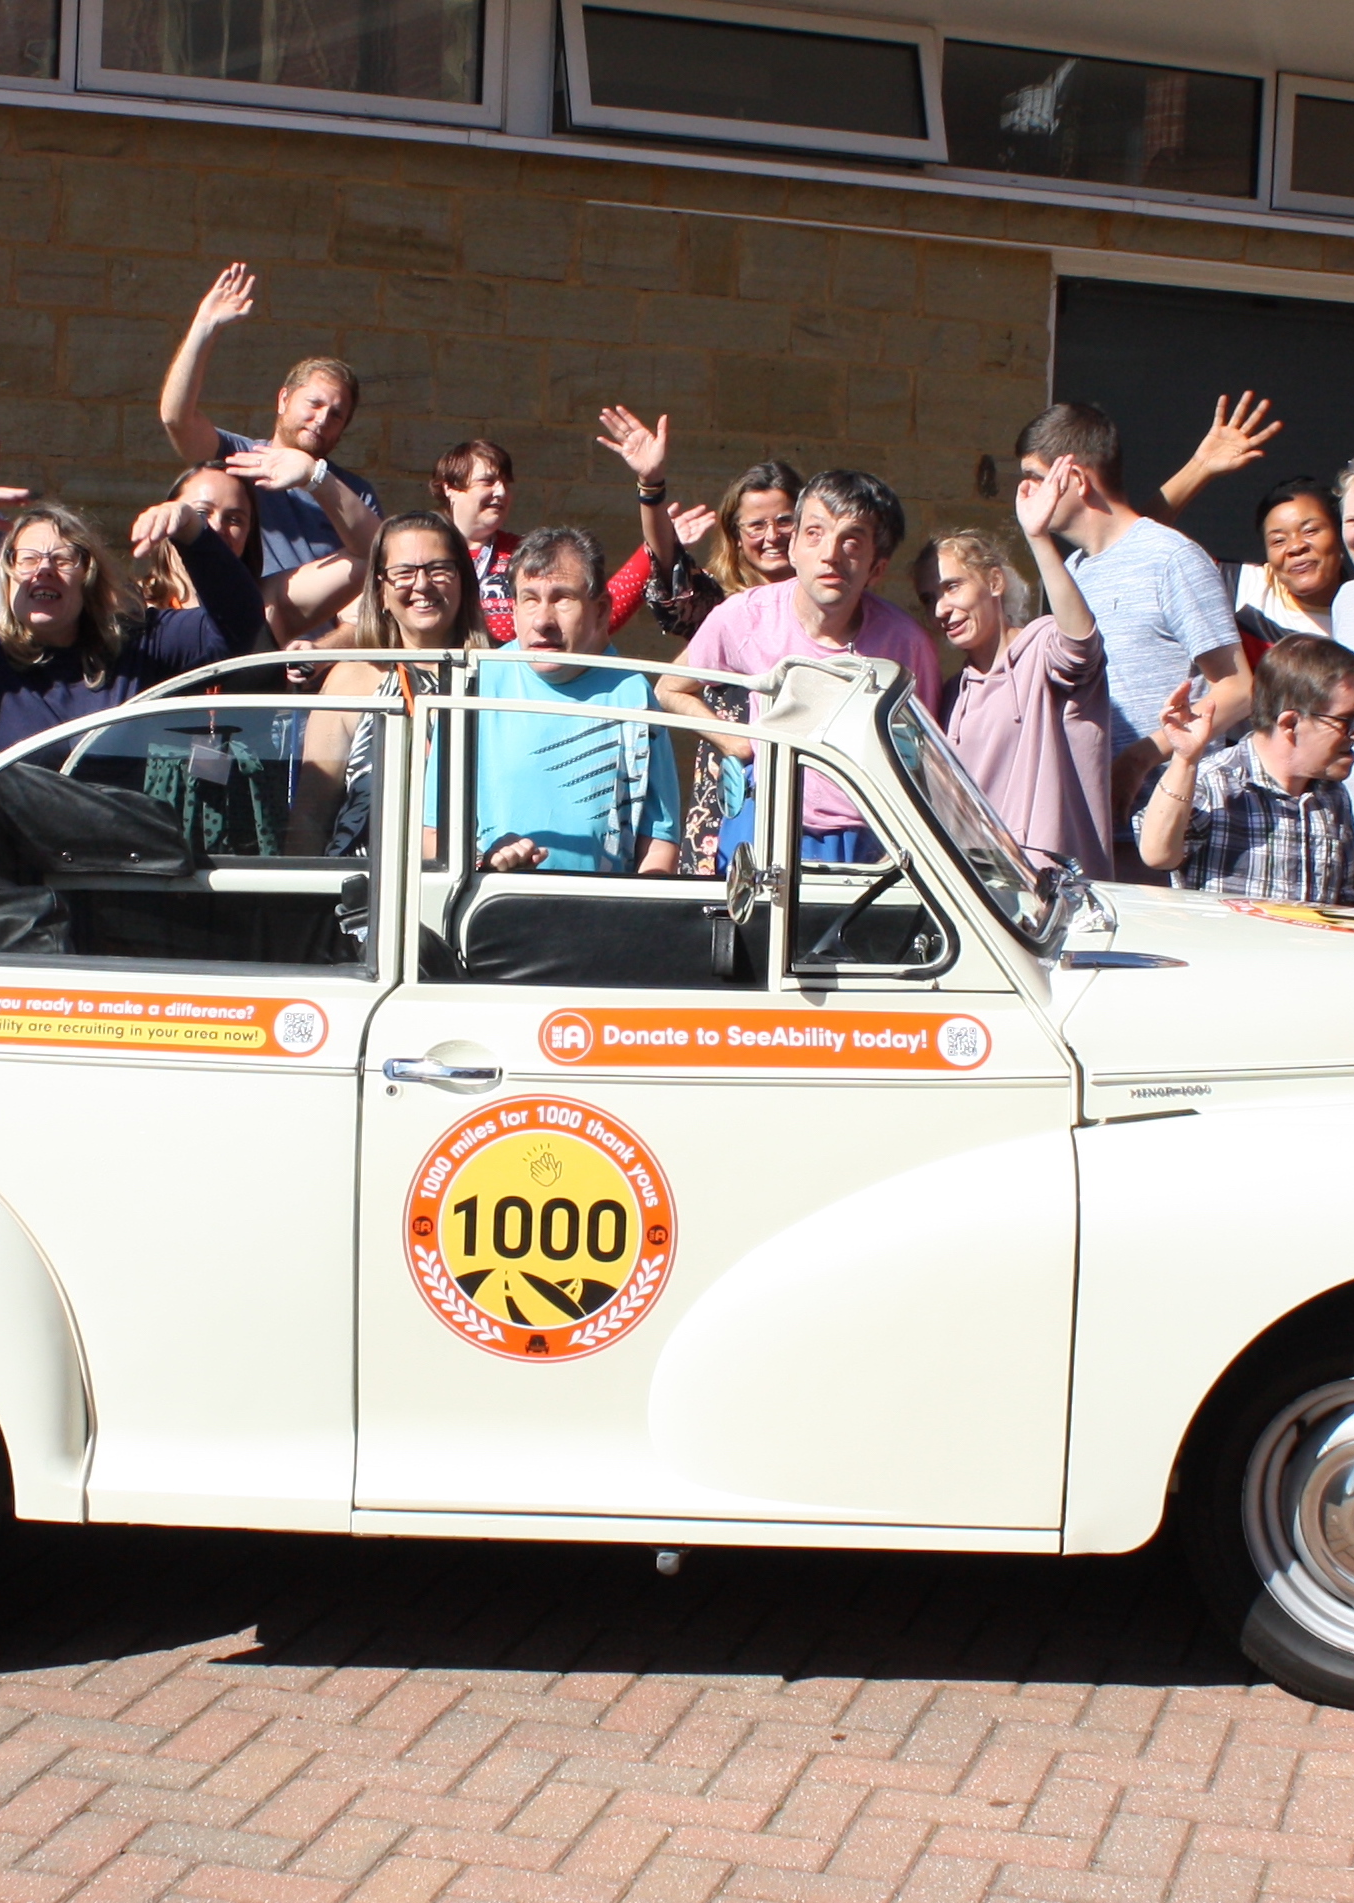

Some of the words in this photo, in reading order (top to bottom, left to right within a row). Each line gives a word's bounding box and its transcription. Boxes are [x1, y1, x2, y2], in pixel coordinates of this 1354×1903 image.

[26, 997, 73, 1015] ready
[78, 999, 94, 1013] to
[99, 1000, 143, 1015] make
[148, 1003, 160, 1016] a
[164, 1002, 255, 1020] difference?
[28, 1021, 52, 1032] are
[57, 1022, 125, 1039] recruiting
[130, 1024, 142, 1037] in
[148, 1028, 181, 1041] your
[184, 1028, 218, 1040] area
[224, 1029, 258, 1042] now!
[551, 1025, 563, 1048] SEE
[563, 1025, 585, 1048] A
[603, 1025, 689, 1045] Donate
[696, 1026, 720, 1045] to
[727, 1025, 846, 1052] SeeAbility
[852, 1029, 928, 1054] today!
[420, 1156, 452, 1199] 1000
[450, 1120, 497, 1158] miles
[499, 1110, 528, 1129] for
[536, 1105, 583, 1129] 1000
[585, 1119, 635, 1164] thank
[627, 1163, 658, 1208] yous
[453, 1194, 627, 1263] 1000
